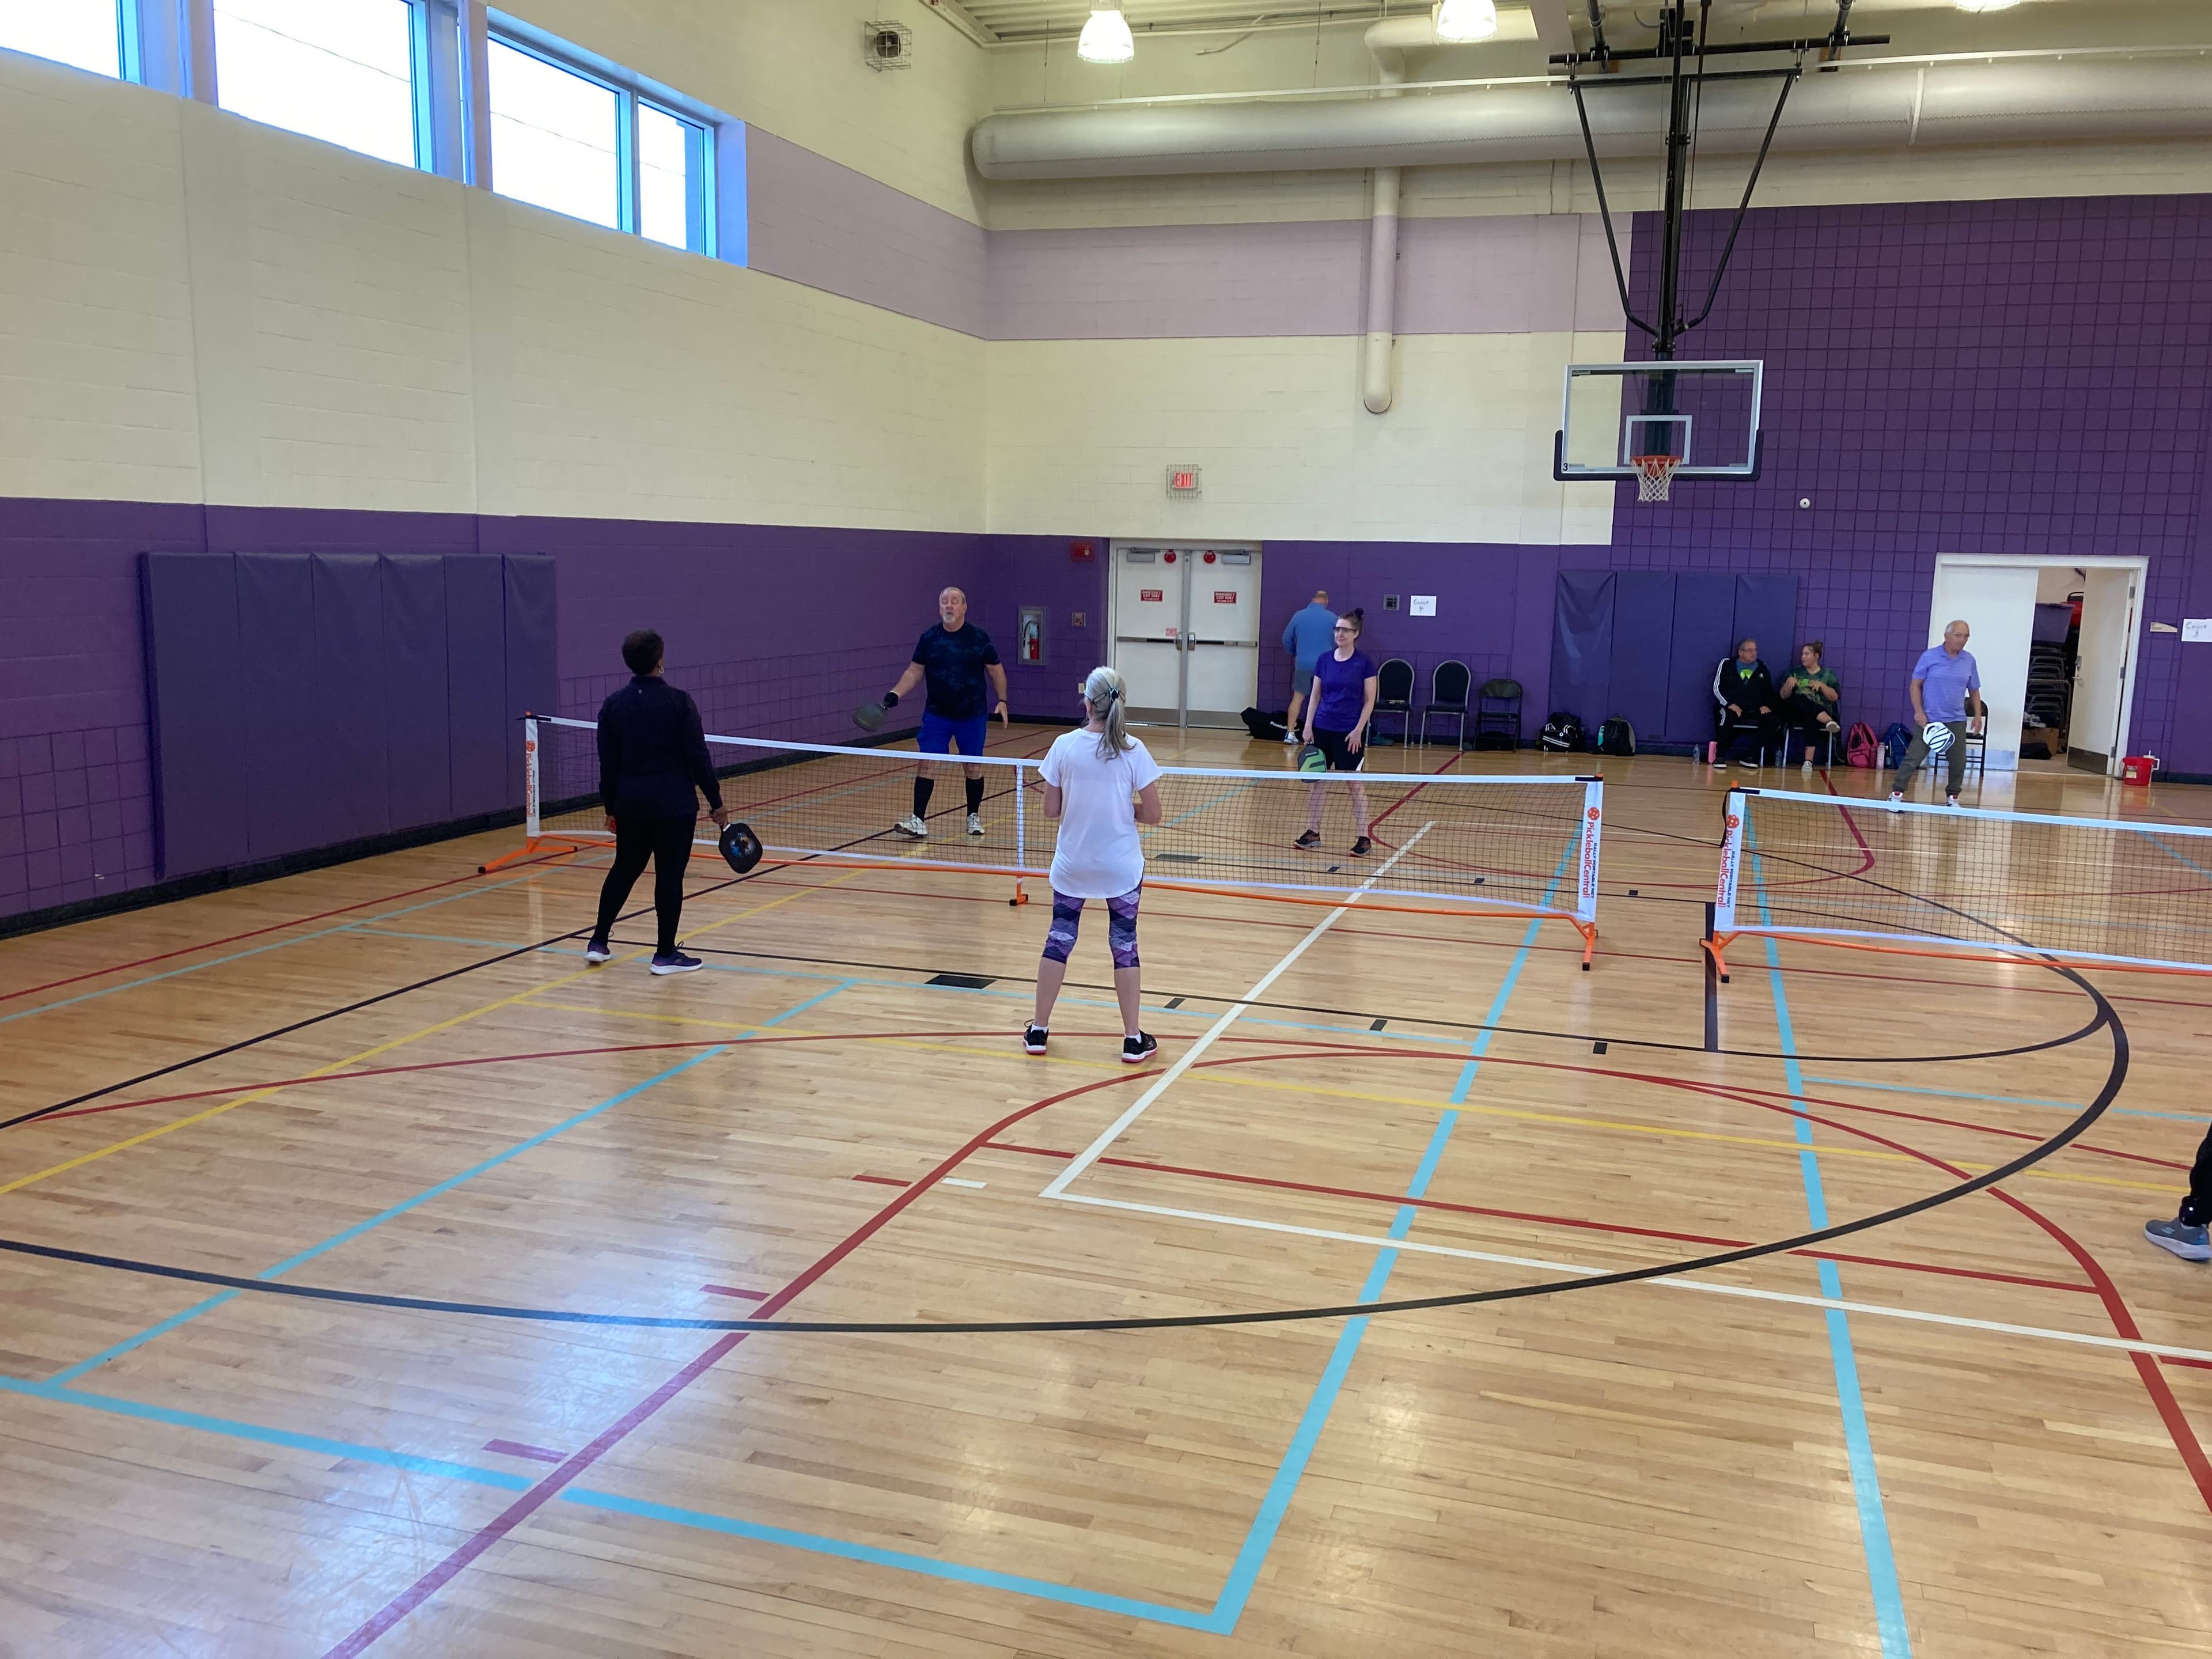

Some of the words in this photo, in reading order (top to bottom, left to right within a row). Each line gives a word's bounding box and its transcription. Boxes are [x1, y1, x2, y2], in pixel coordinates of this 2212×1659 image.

[1563, 463, 1568, 471] 3
[1175, 472, 1193, 487] EXIT
[1419, 605, 1424, 613] 4
